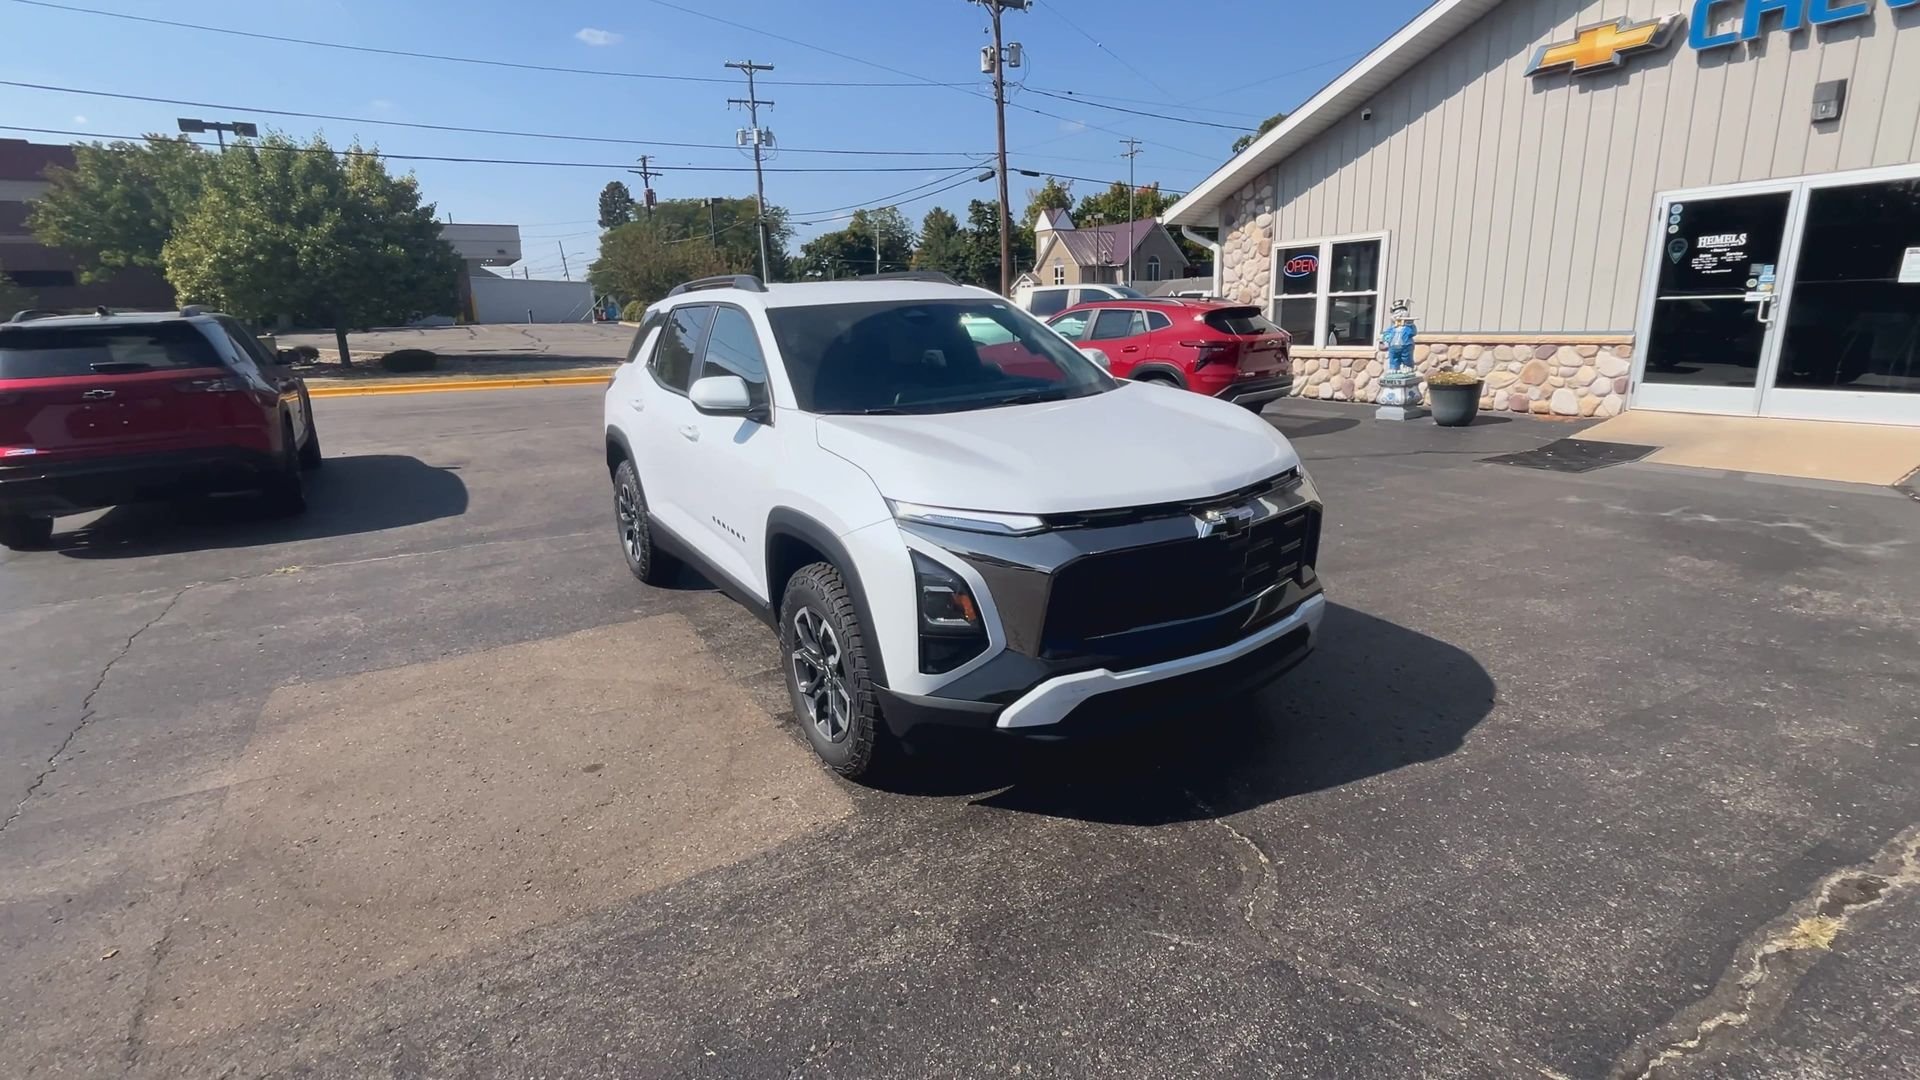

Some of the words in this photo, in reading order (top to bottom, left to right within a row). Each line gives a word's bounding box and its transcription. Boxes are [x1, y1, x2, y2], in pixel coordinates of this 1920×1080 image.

[1688, 0, 1920, 50] CH
[1696, 233, 1747, 248] HEMELS
[1286, 259, 1316, 273] OPEN
